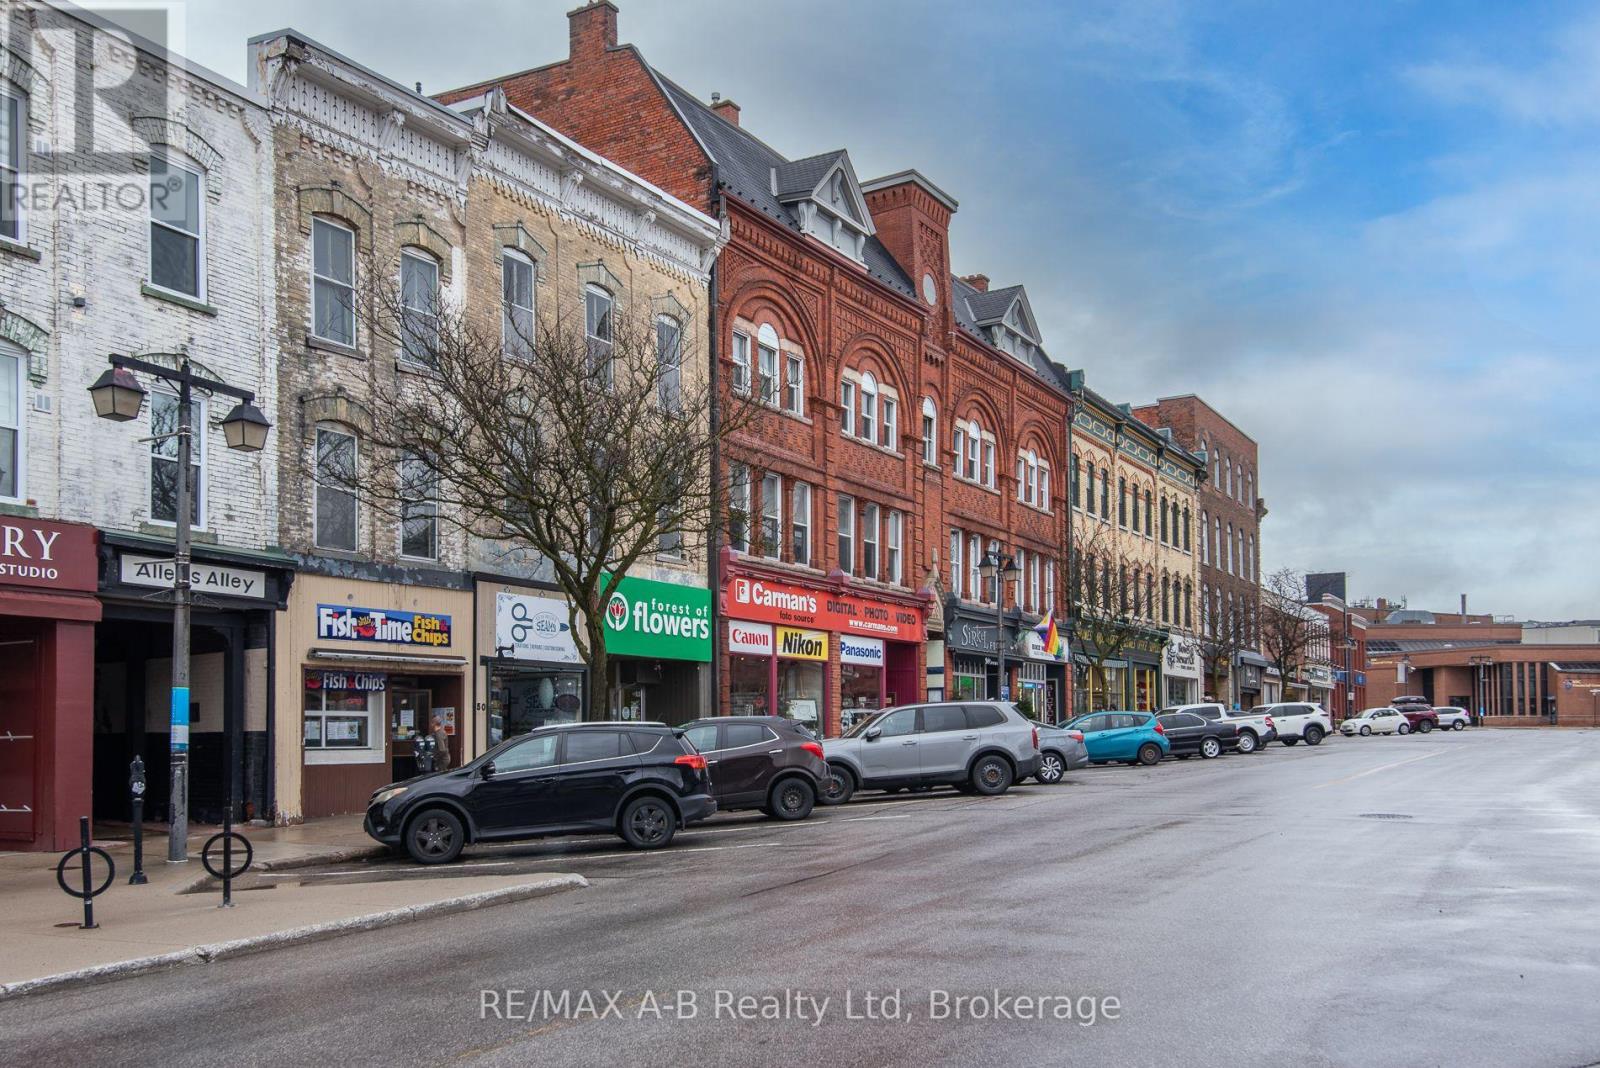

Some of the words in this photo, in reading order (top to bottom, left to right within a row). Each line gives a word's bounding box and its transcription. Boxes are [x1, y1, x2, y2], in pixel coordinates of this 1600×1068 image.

[0, 563, 58, 579] STUDIO
[136, 563, 201, 584] Alles
[206, 571, 254, 593] Alley
[752, 582, 817, 613] Carman's
[651, 598, 690, 615] forest
[696, 605, 708, 617] of
[826, 600, 857, 616] DIGITAL
[864, 606, 888, 620] PHOTO
[896, 612, 916, 625] VIDEO
[320, 608, 357, 638] Fish
[369, 612, 412, 642] Time
[414, 615, 440, 630] Fish
[536, 620, 557, 632] SEAMS
[632, 601, 709, 639] flowers
[793, 613, 815, 624] source
[412, 629, 449, 645] Chips
[732, 628, 769, 646] Canon
[782, 631, 823, 656] Nikon
[840, 641, 882, 659] Panasonic
[323, 673, 347, 689] Fish
[355, 674, 385, 691] Chips
